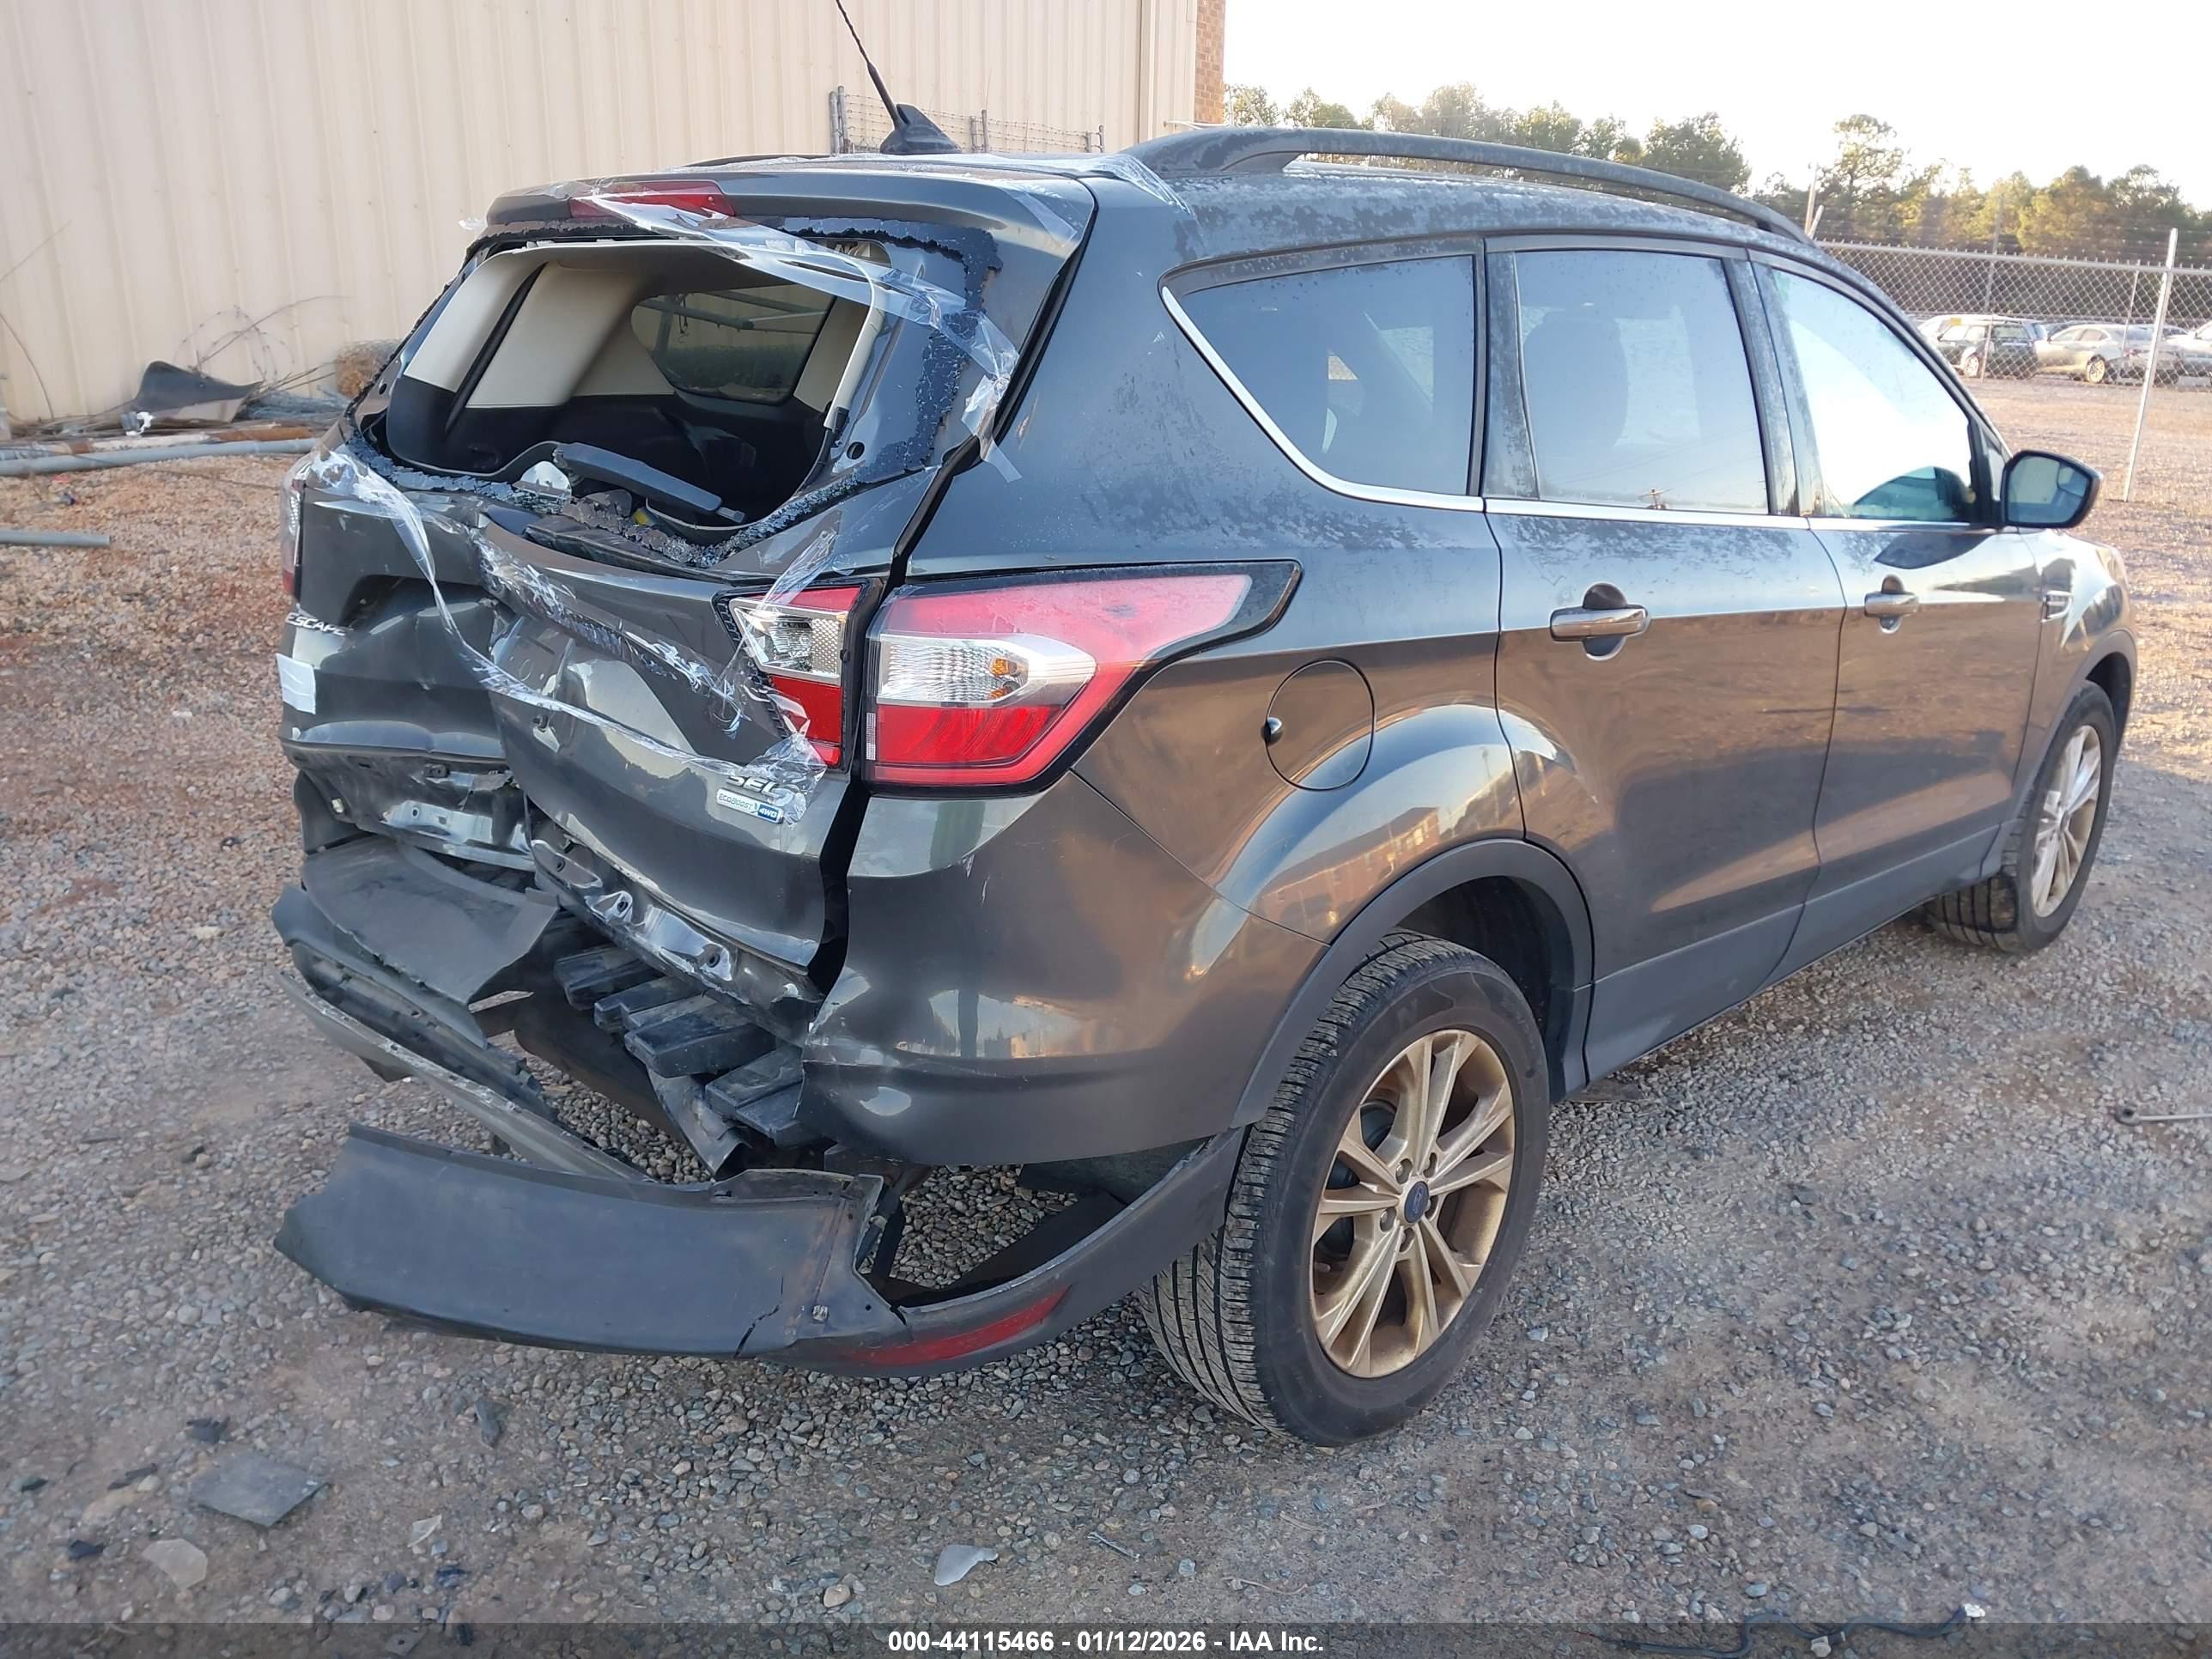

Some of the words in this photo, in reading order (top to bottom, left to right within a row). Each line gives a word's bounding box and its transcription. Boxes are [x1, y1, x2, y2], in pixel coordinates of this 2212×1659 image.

[285, 612, 346, 636] ESCAPE
[726, 775, 781, 799] SEL
[757, 807, 778, 818] 4WD
